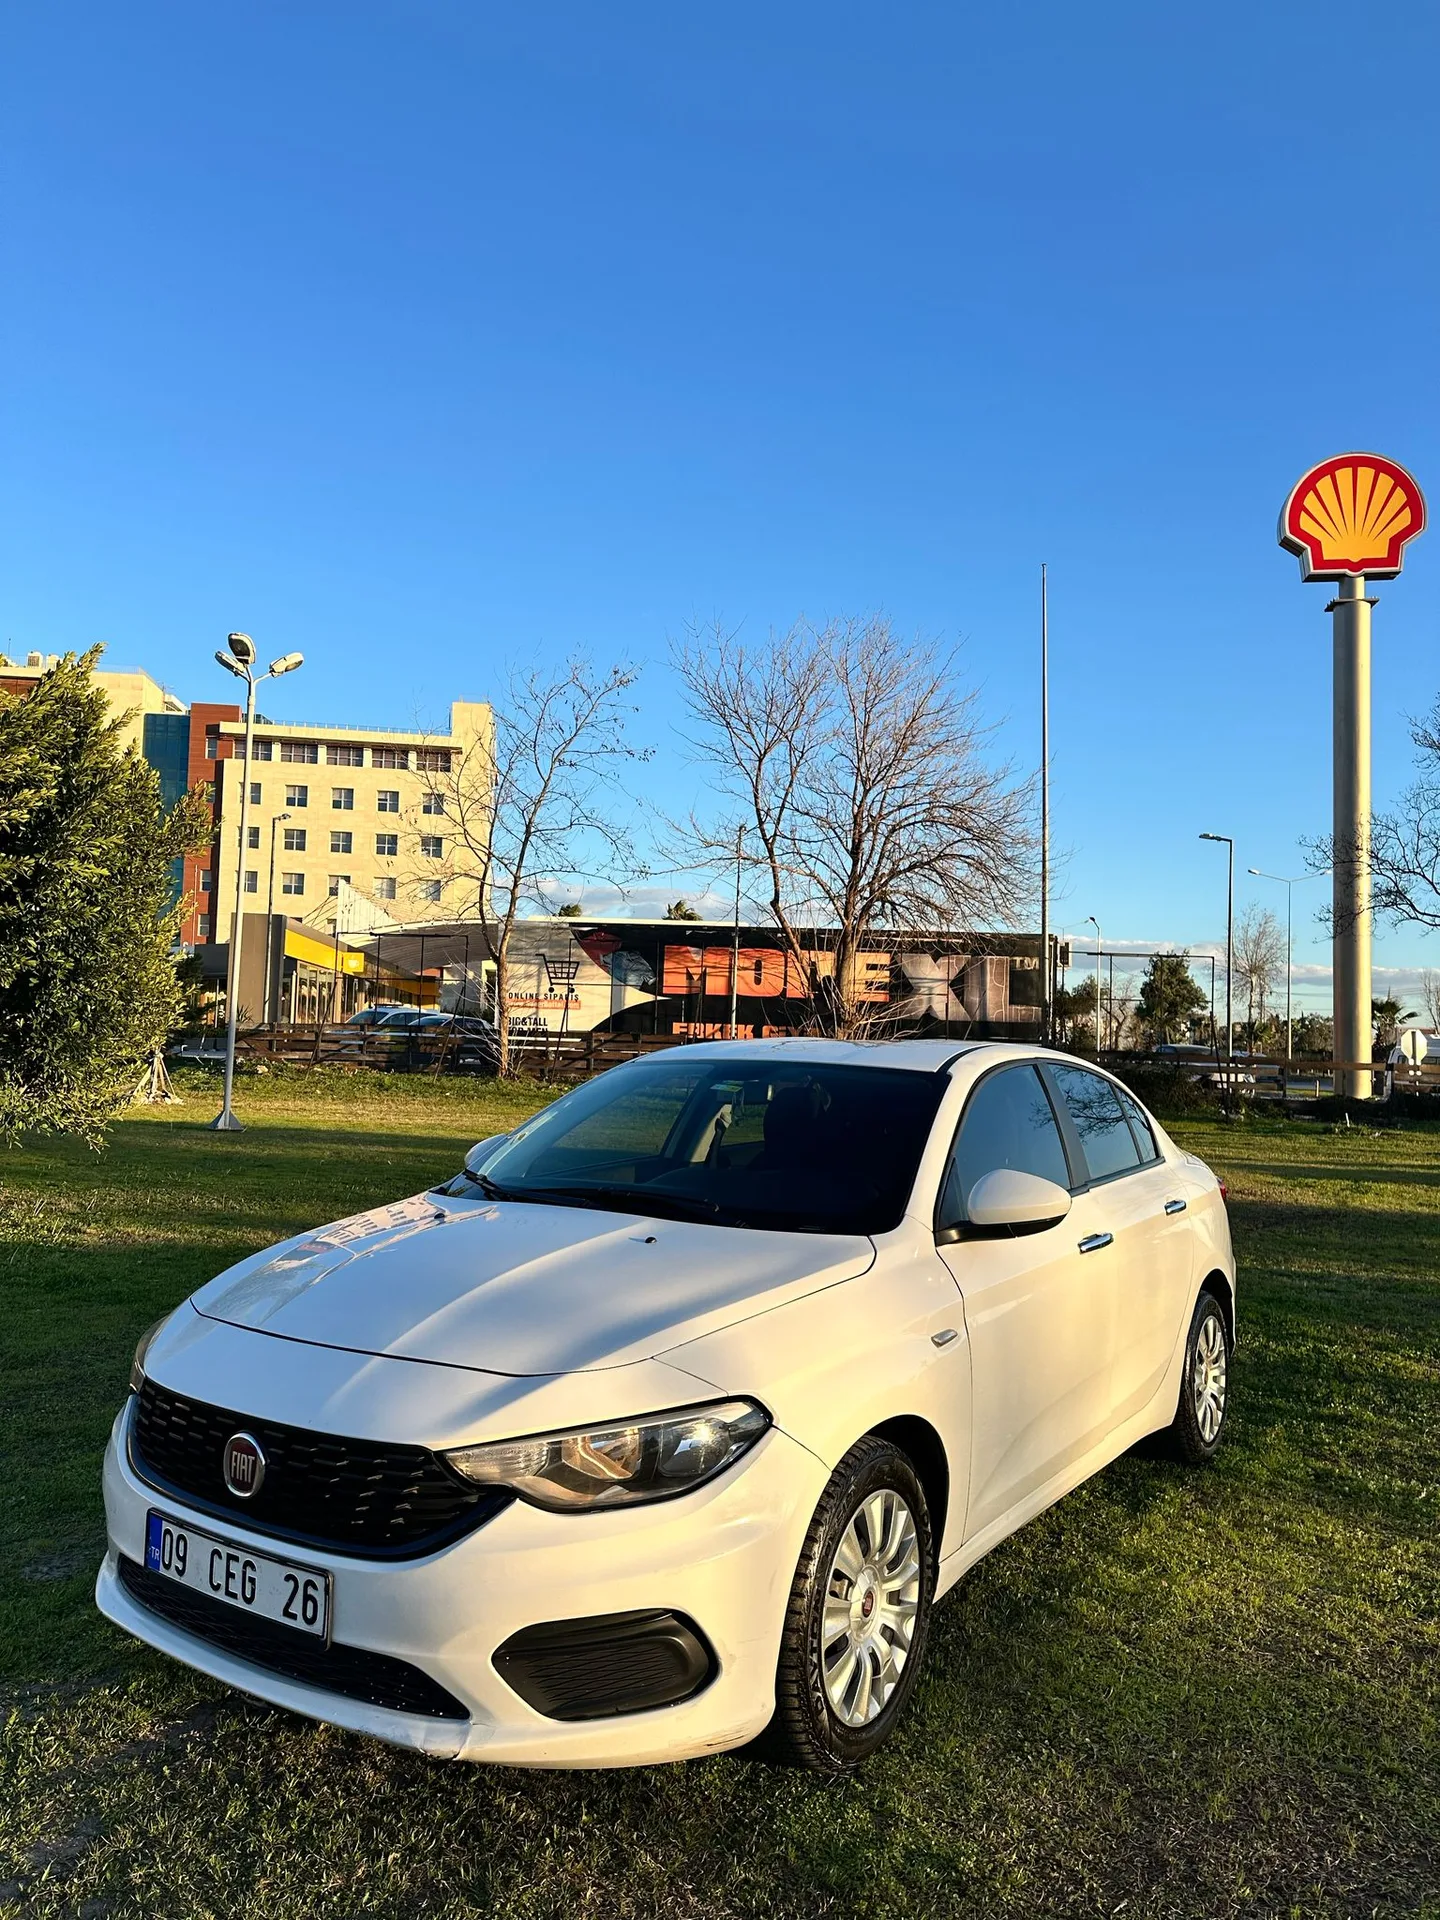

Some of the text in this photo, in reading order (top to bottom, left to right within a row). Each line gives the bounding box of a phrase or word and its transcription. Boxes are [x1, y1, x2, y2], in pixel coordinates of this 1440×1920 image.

[508, 992, 540, 1000] ONLINE
[672, 1022, 755, 1040] ERKEK
[231, 1451, 256, 1483] FIAT
[151, 1546, 160, 1562] TR
[162, 1527, 319, 1626] 09 CEG 26
